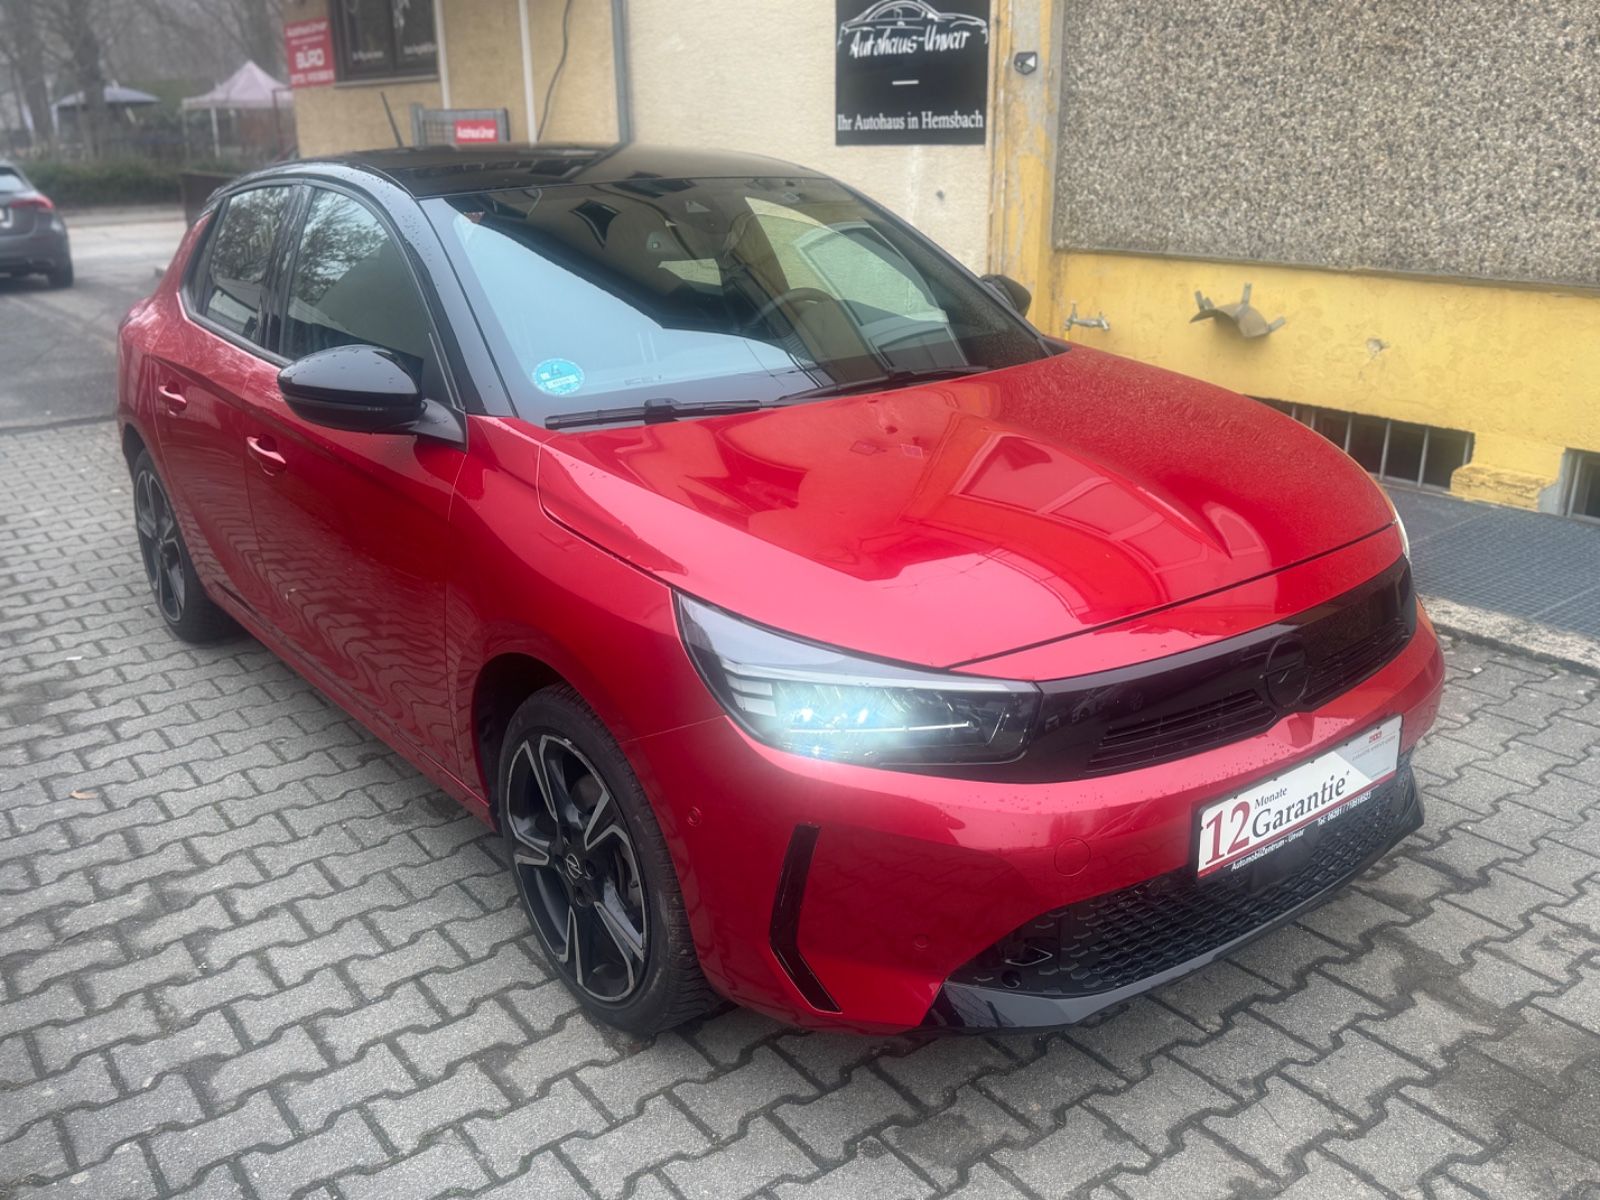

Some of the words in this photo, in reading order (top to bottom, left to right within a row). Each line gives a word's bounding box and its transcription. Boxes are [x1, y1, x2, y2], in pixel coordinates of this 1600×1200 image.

[837, 114, 853, 131] Ihr
[854, 112, 905, 131] Autohaus
[907, 111, 919, 129] in
[921, 109, 984, 129] Hemsbach
[1254, 786, 1288, 810] Monate
[1205, 801, 1251, 866] 12
